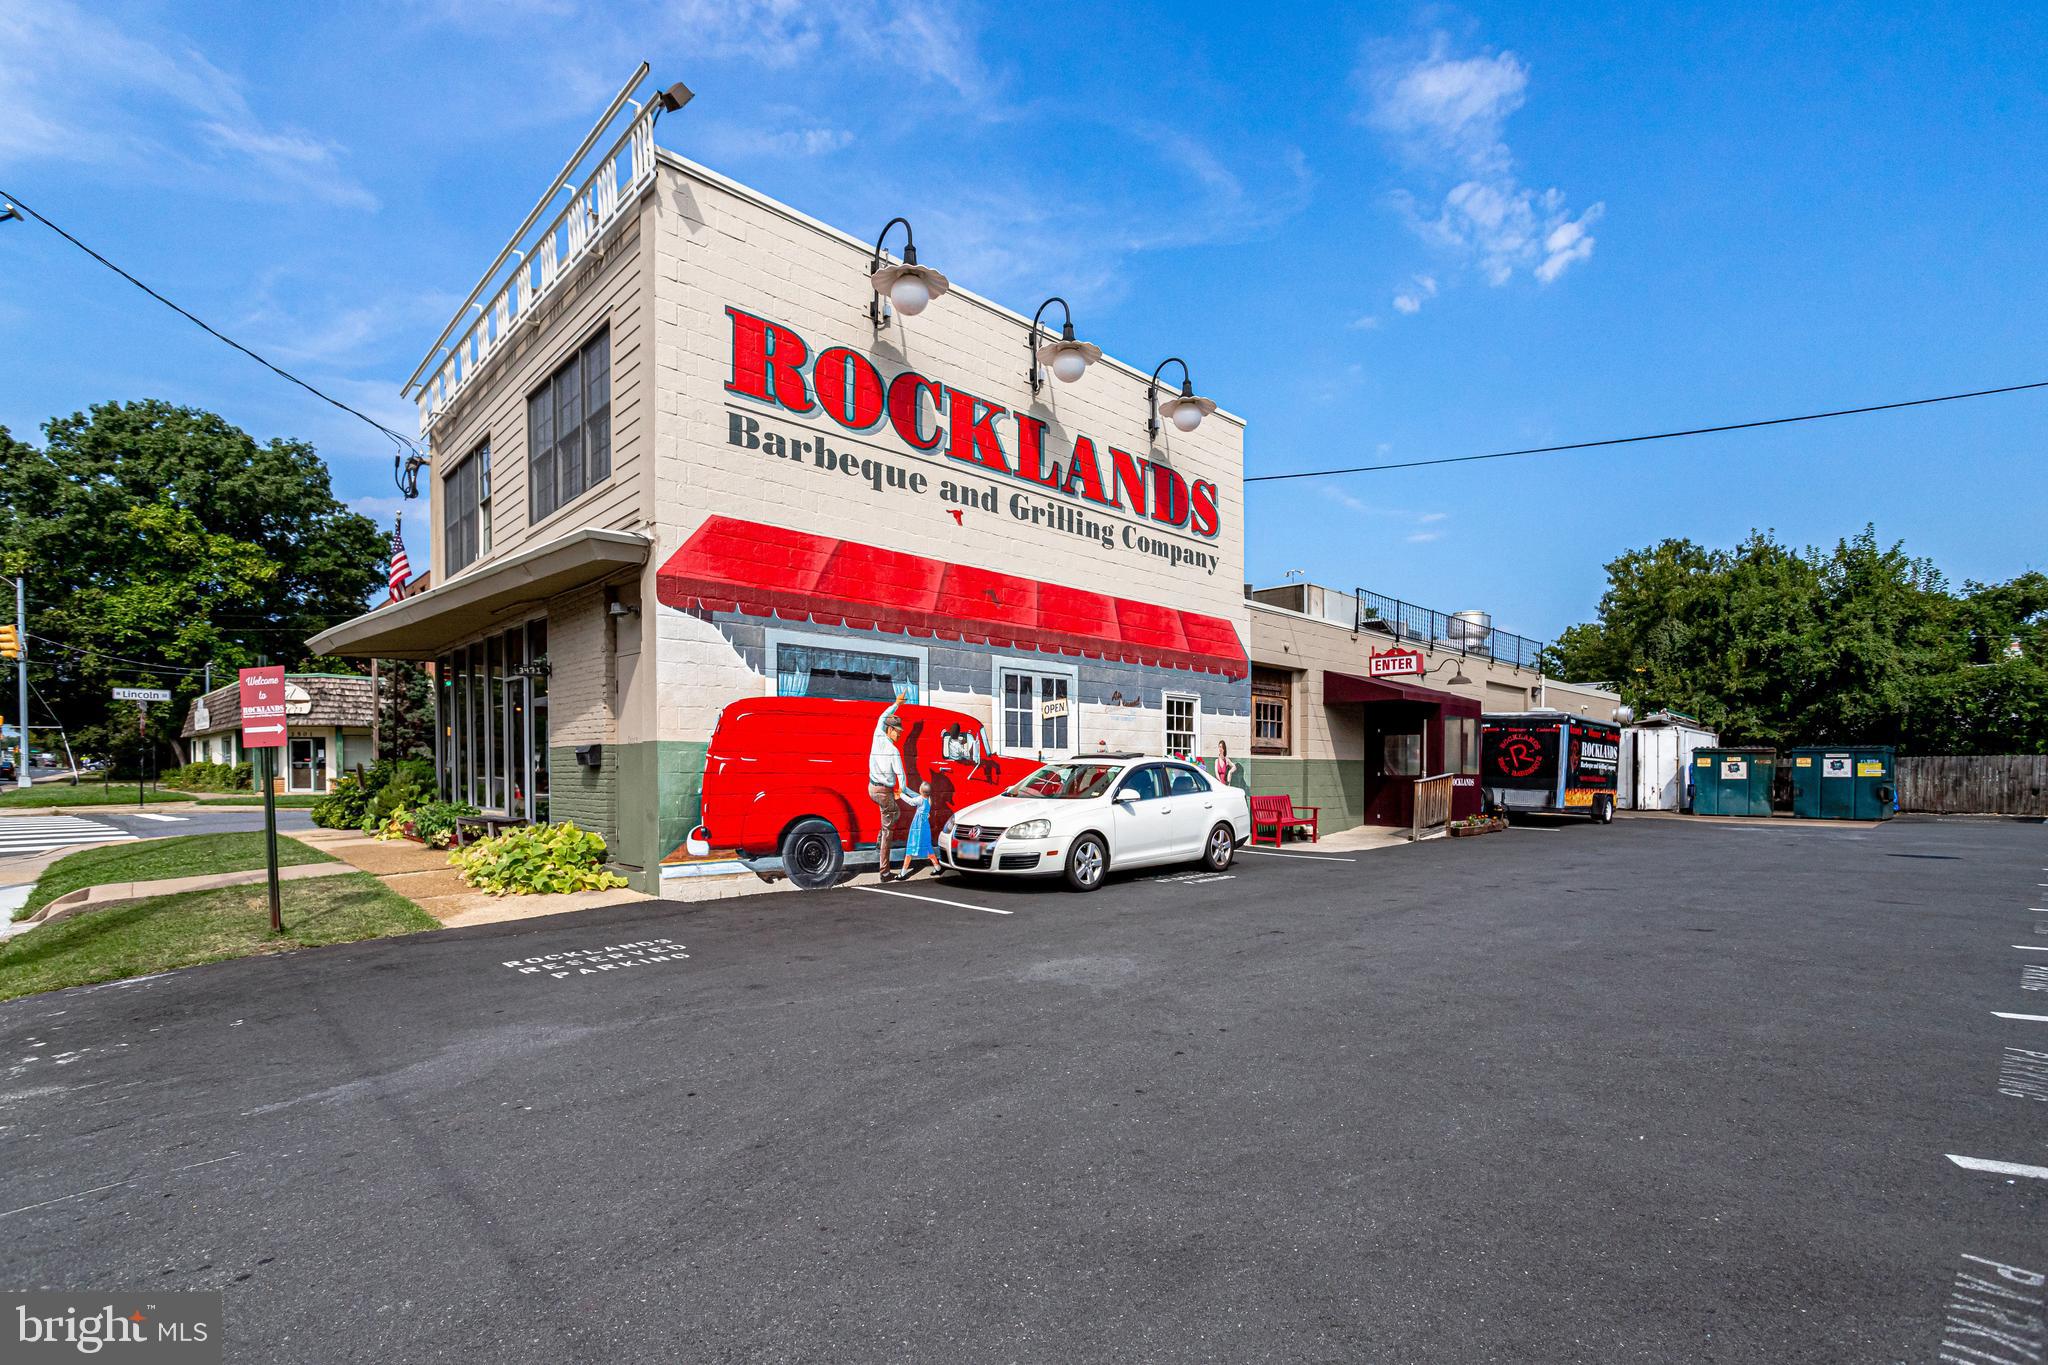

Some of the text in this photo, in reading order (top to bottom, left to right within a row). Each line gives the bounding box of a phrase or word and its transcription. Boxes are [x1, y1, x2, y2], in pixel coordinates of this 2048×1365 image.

[723, 304, 1221, 540] ROCKLANDS
[726, 411, 1220, 575] Barbeque and Grilling Company
[1375, 658, 1412, 671] ENTER
[245, 676, 279, 686] Welcome
[123, 691, 159, 699] Lincoln
[258, 691, 267, 700] to
[242, 705, 285, 714] ROCKLANDS
[1044, 702, 1065, 714] OPEN
[1581, 742, 1617, 759] ROCKLANDS
[517, 944, 687, 975] RESERVED
[550, 953, 690, 979] PARKING
